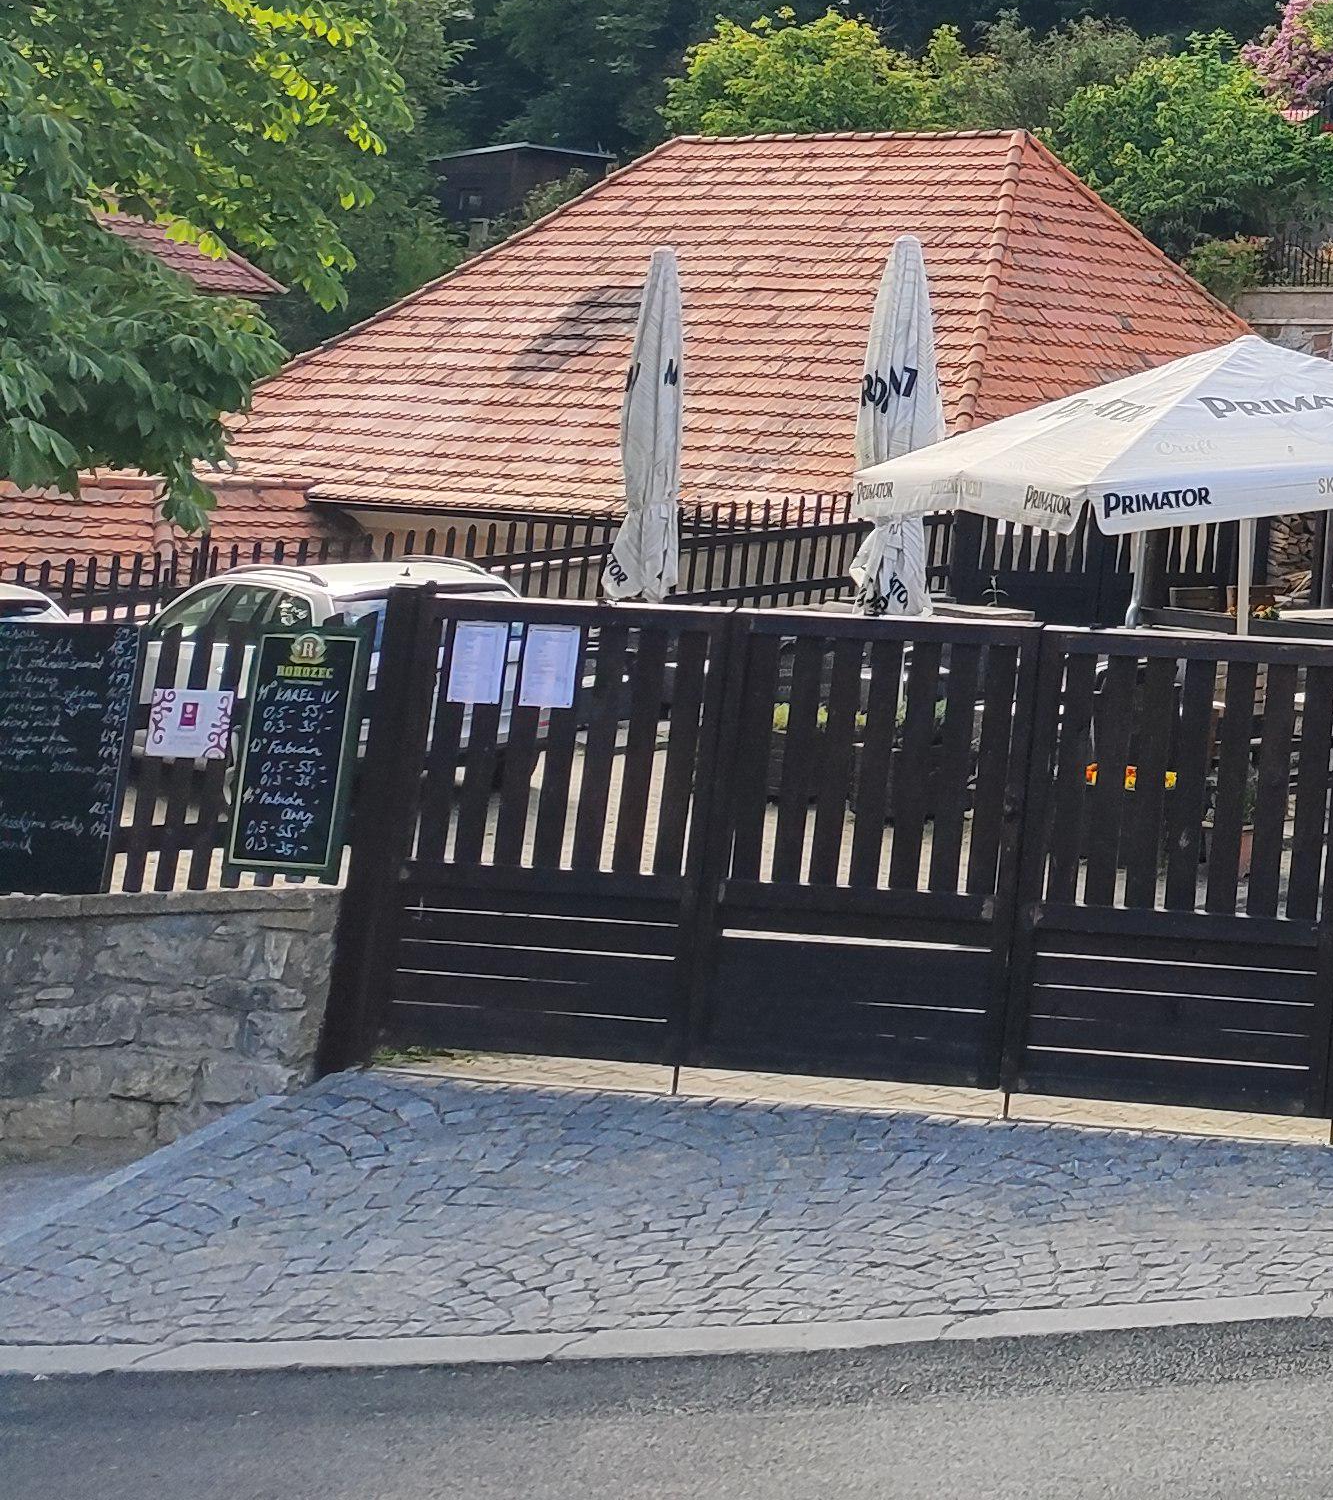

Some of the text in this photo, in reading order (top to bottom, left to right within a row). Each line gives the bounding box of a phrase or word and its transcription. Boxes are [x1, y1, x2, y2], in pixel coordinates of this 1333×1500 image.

[1023, 484, 1072, 517] PRIMATOR
[1103, 486, 1212, 519] PRIMATOR
[275, 687, 316, 703] KAREL
